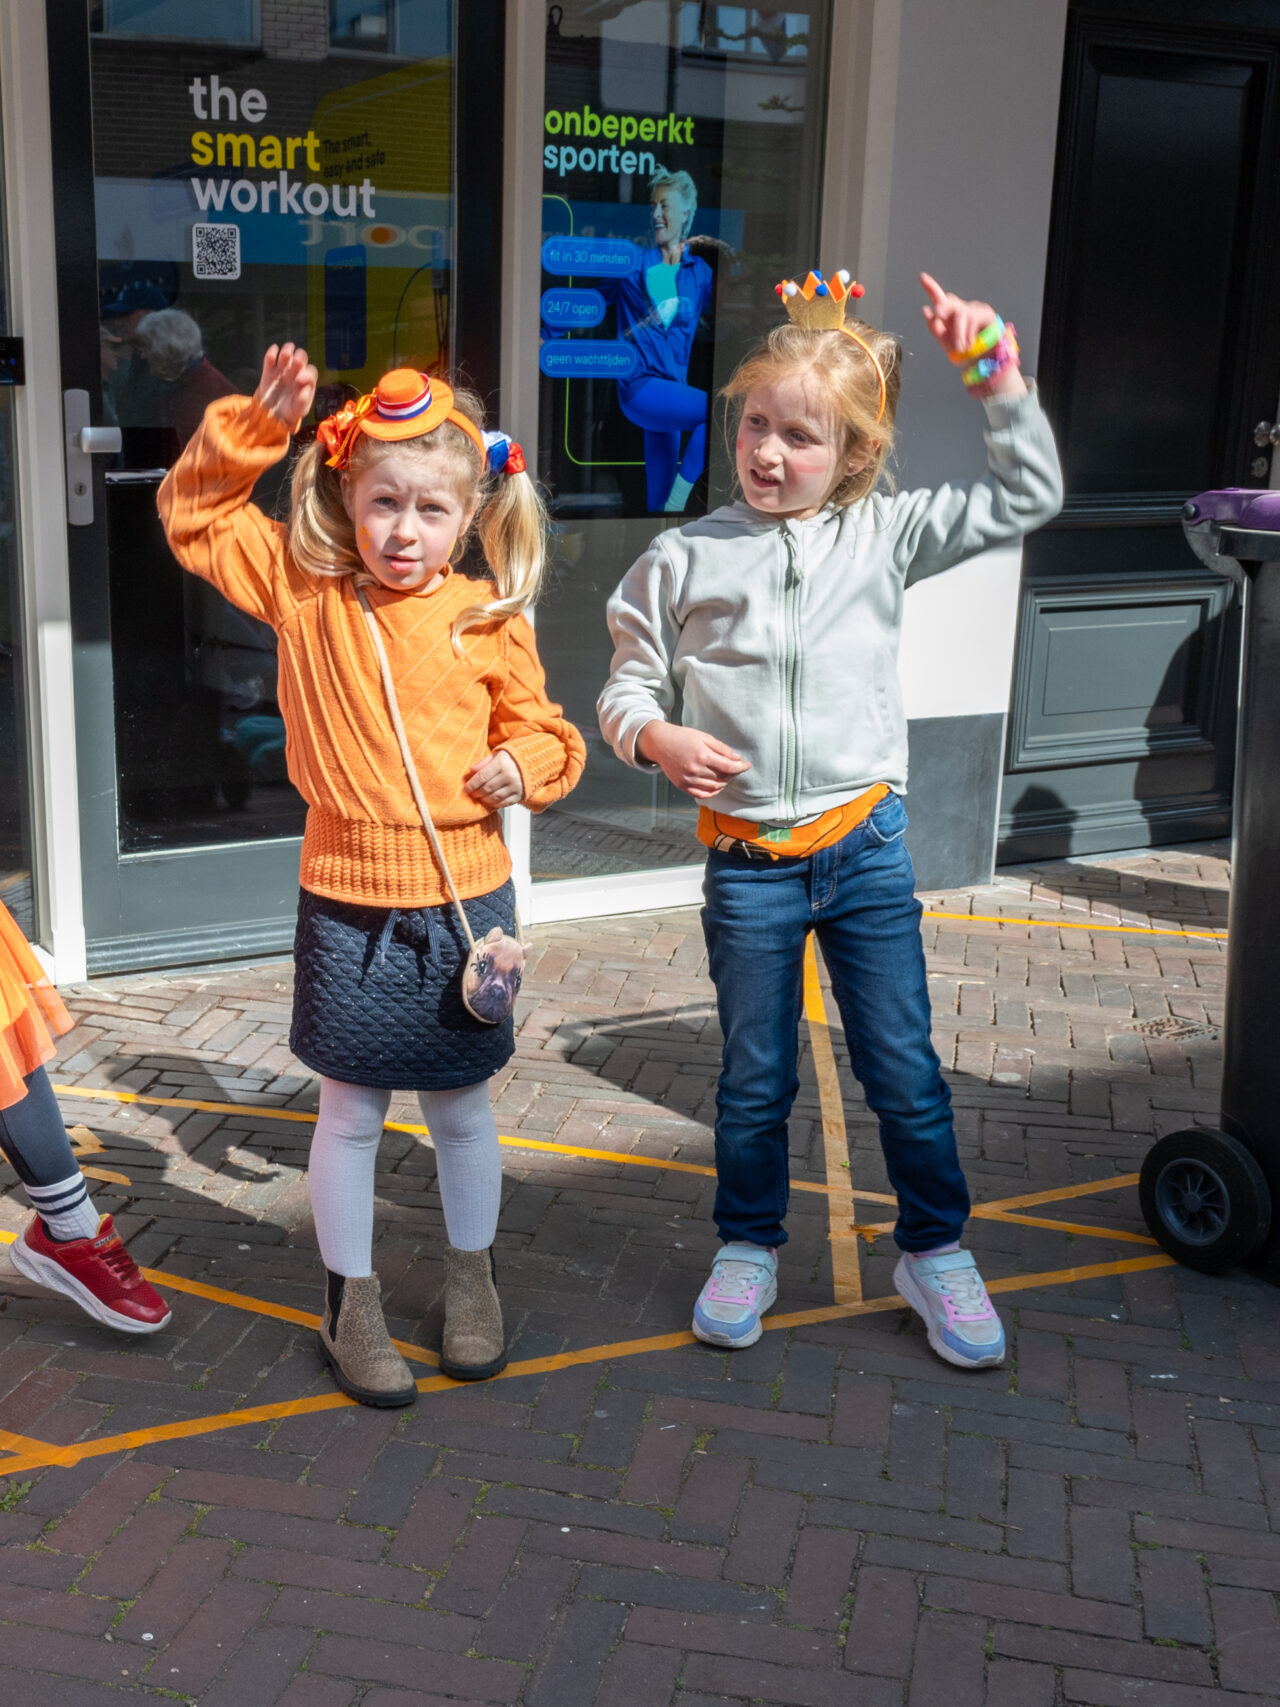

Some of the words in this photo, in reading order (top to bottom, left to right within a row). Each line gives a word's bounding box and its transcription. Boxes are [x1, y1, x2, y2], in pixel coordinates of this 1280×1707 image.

[189, 75, 268, 123] the
[545, 105, 695, 147] onbeperkt
[191, 130, 320, 172] smart
[323, 139, 340, 155] The
[323, 163, 344, 179] easy
[543, 144, 656, 177] sporten
[190, 171, 376, 218] workout
[549, 249, 562, 262] fit
[563, 250, 573, 262] in
[574, 251, 588, 263] 30
[590, 251, 631, 266] minuten
[547, 301, 570, 315] 24/7
[572, 303, 598, 318] open
[545, 354, 573, 367] geen
[574, 353, 631, 369] wachttijden
